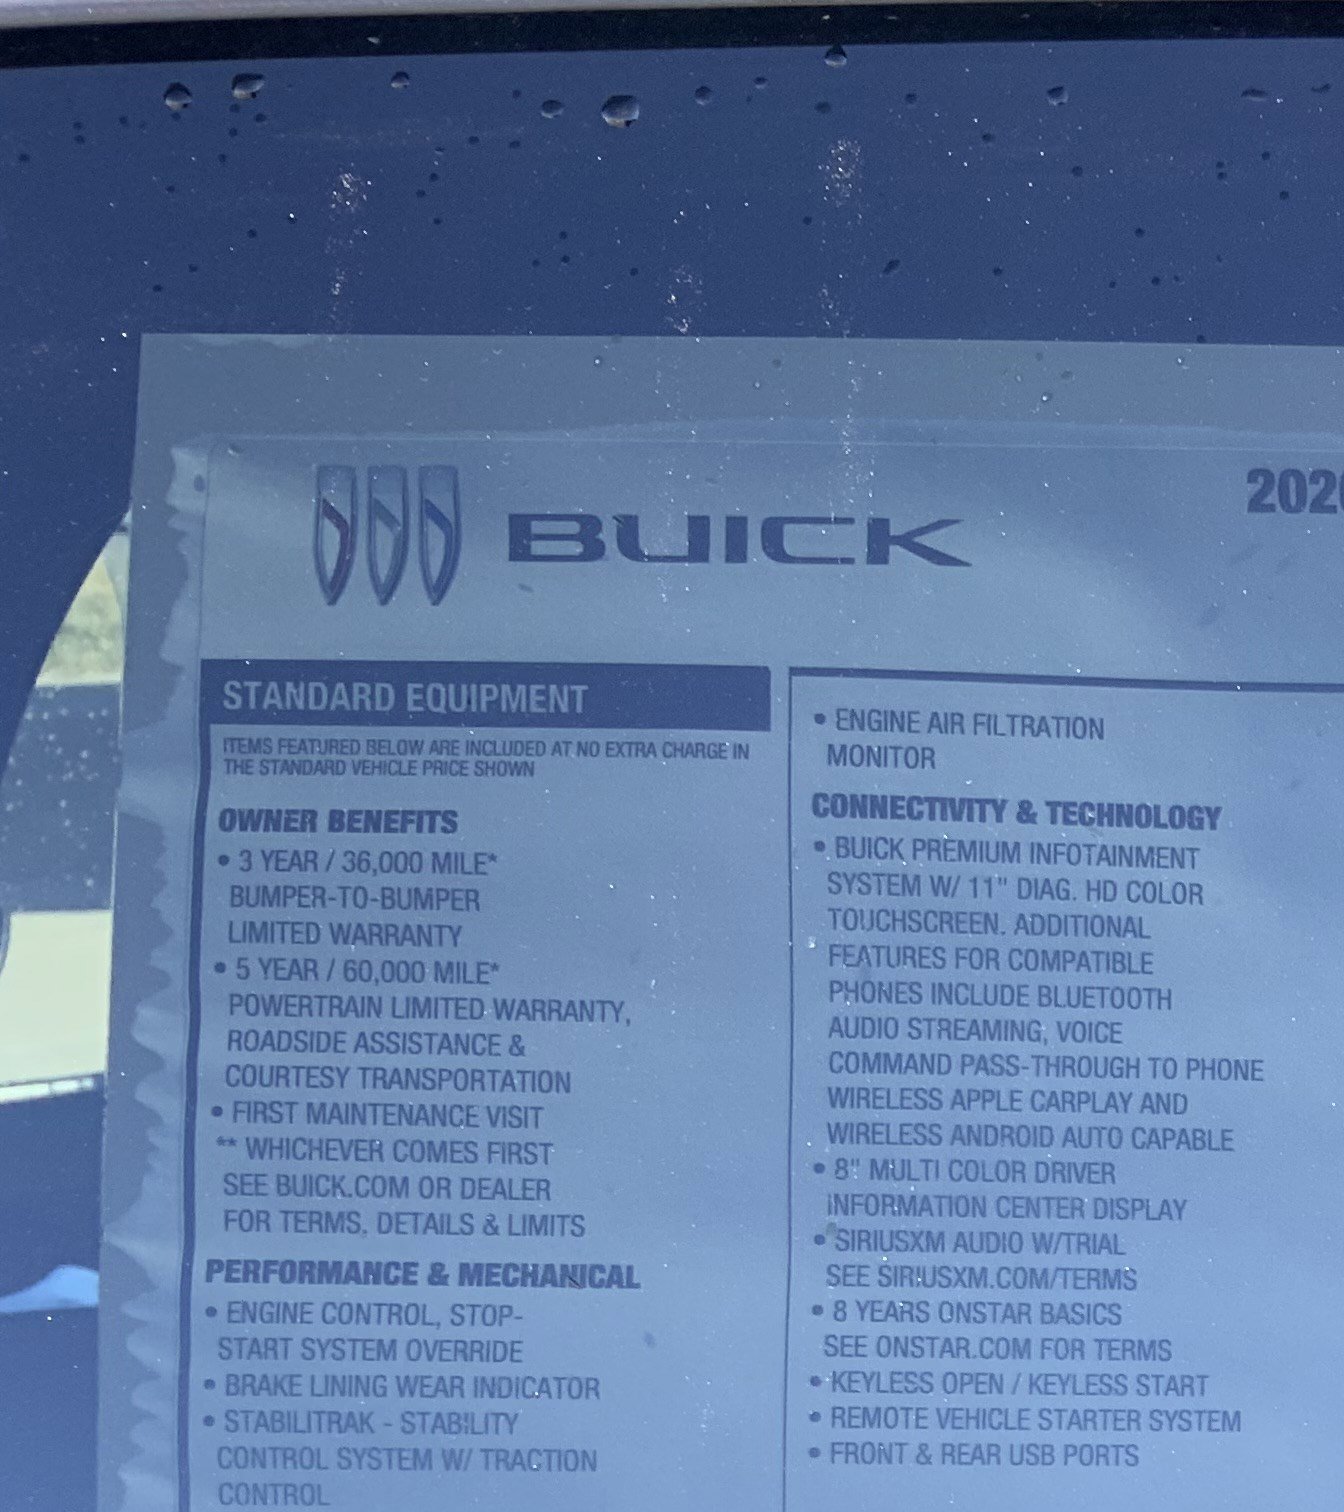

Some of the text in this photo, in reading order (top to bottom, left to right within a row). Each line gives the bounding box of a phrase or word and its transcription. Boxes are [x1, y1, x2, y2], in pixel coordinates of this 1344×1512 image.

[508, 513, 970, 567] BUICK
[224, 681, 588, 713] STANDARD EQUIPMENT
[219, 808, 458, 834] OWNER BENEFITS
[812, 792, 1221, 830] CONNECTIVITY & TECHNOLOGY
[240, 849, 252, 872] 3
[261, 850, 318, 872] YEAR
[342, 850, 423, 875] 36,000
[206, 1259, 640, 1289] PERFORMANCE & MECHANICAL
[831, 1406, 1241, 1432] REMOTE VEHICLE STARTER SYSTEM
